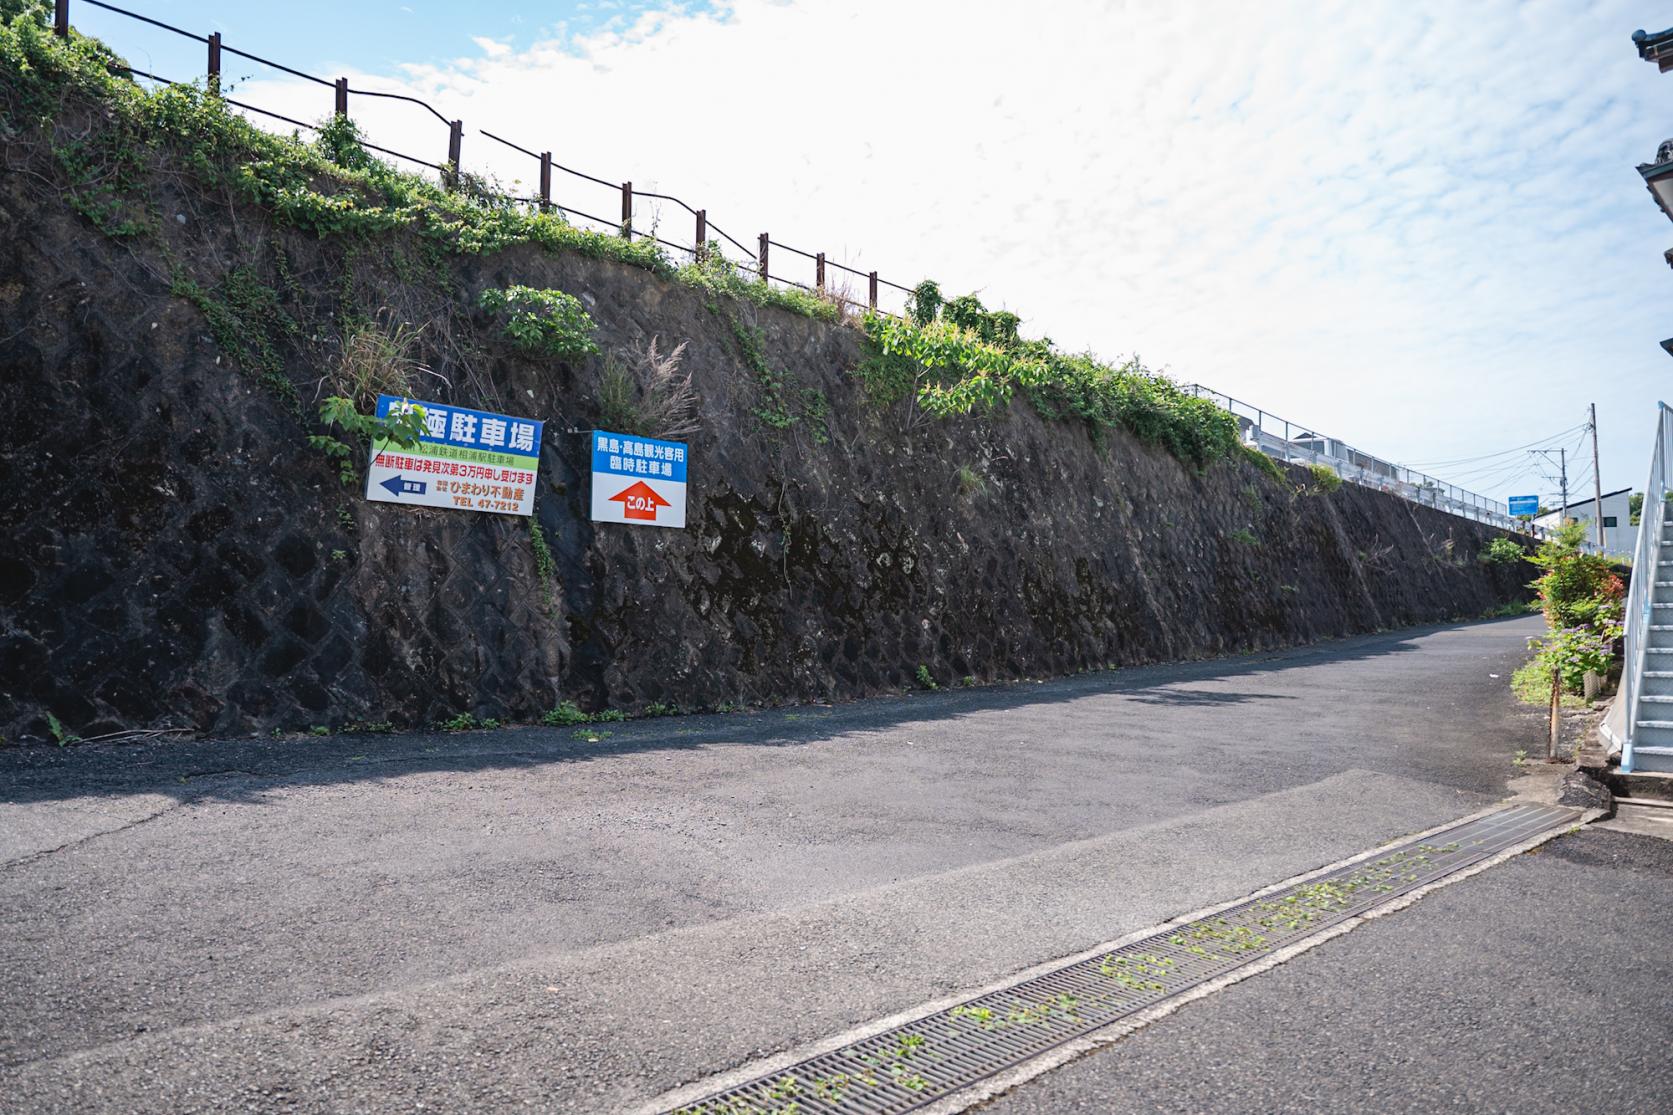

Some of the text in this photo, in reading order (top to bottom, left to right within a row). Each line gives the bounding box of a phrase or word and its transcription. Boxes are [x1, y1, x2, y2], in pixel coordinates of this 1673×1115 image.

[388, 402, 535, 452] 極駐車場
[609, 455, 672, 477] 臨時駐車場
[453, 495, 519, 512] TEL 47-7212
[626, 495, 655, 512] この上
